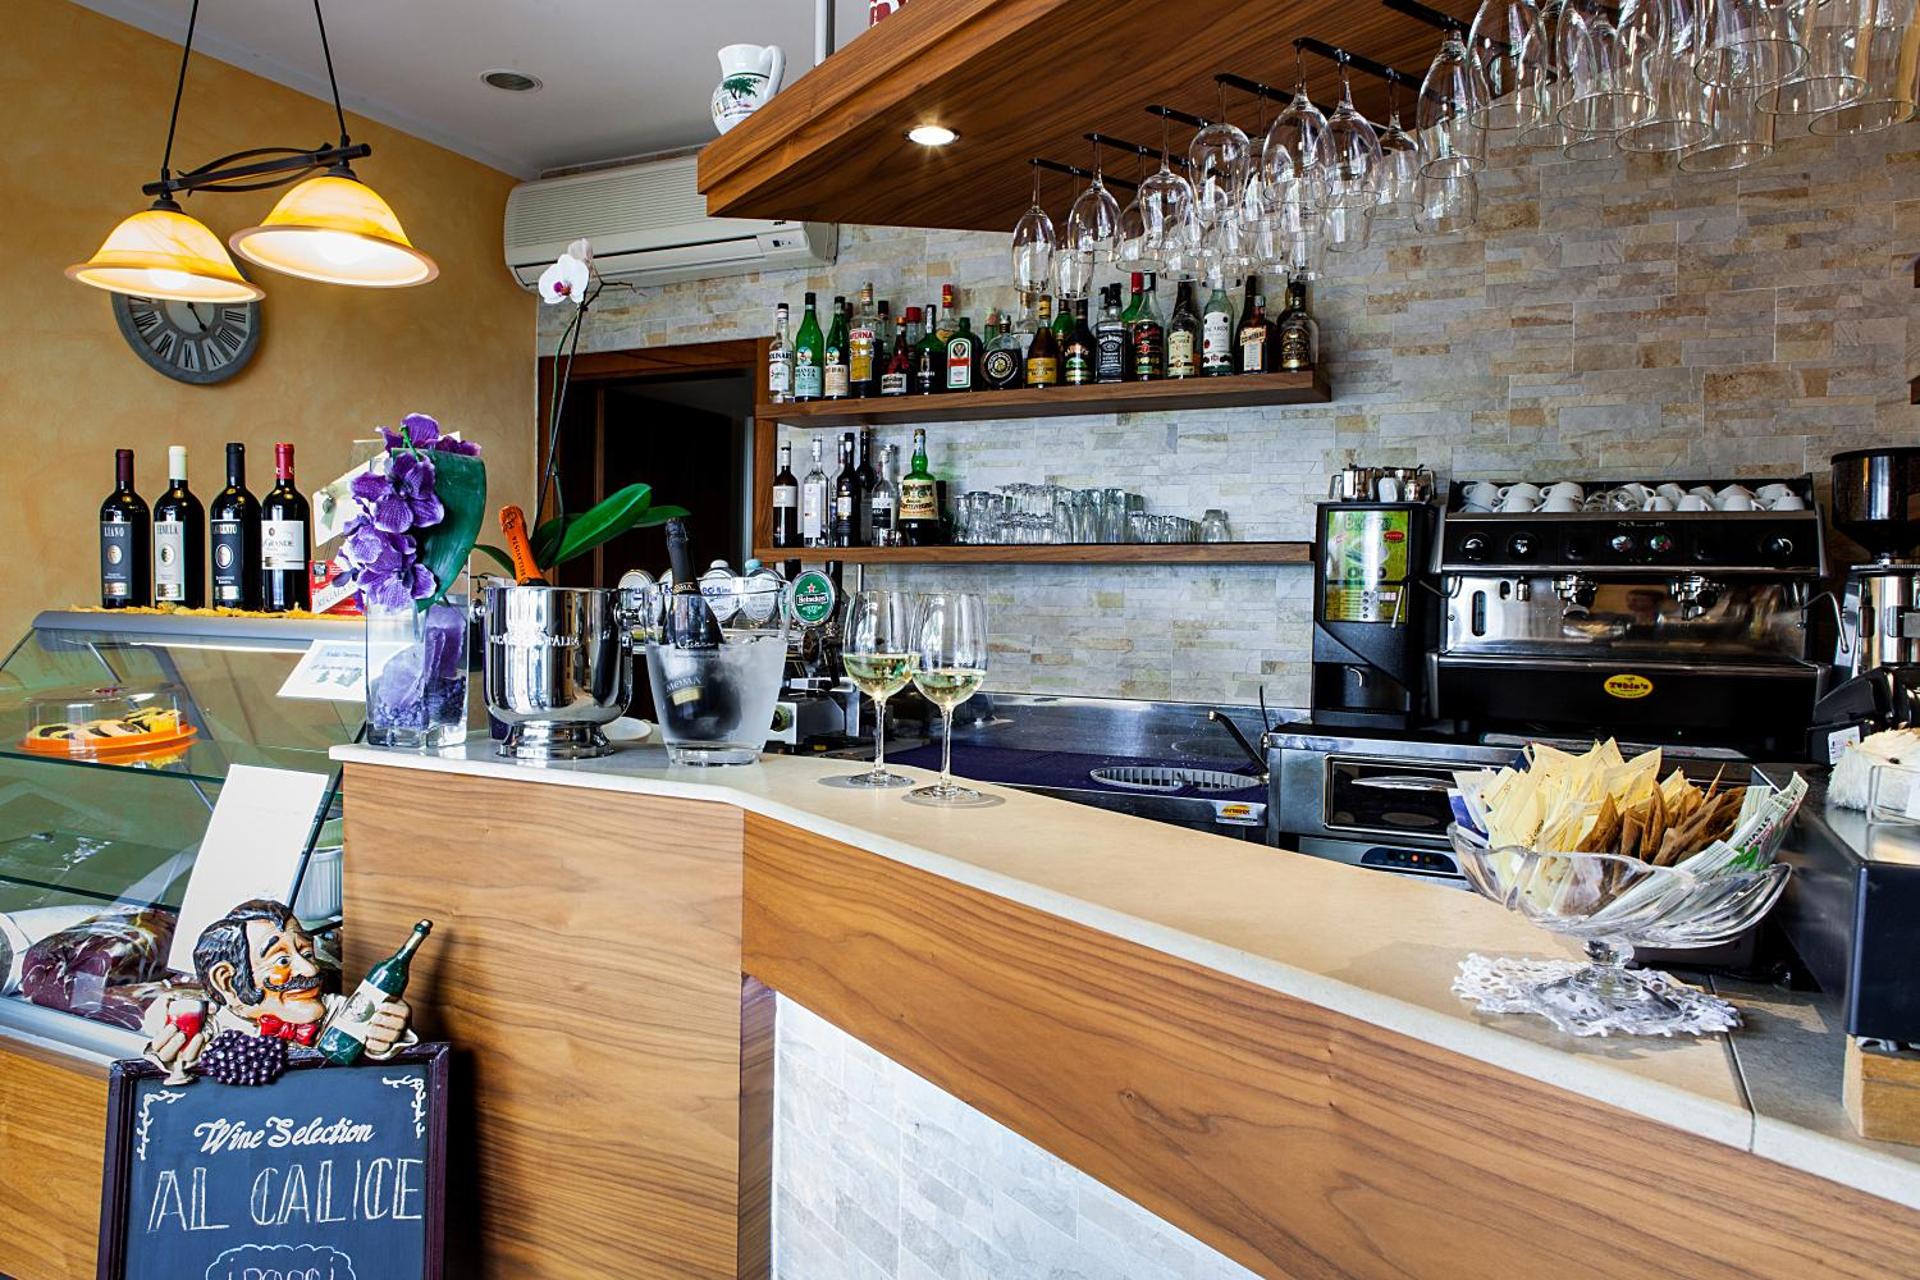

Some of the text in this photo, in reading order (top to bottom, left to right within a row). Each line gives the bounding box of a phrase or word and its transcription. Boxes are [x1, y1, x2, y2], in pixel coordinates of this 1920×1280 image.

[104, 526, 125, 537] LIANO
[797, 595, 828, 604] Heineken
[666, 676, 702, 692] MOMA
[194, 1116, 376, 1154] Wine Selection
[146, 1158, 424, 1234] AL CALICE
